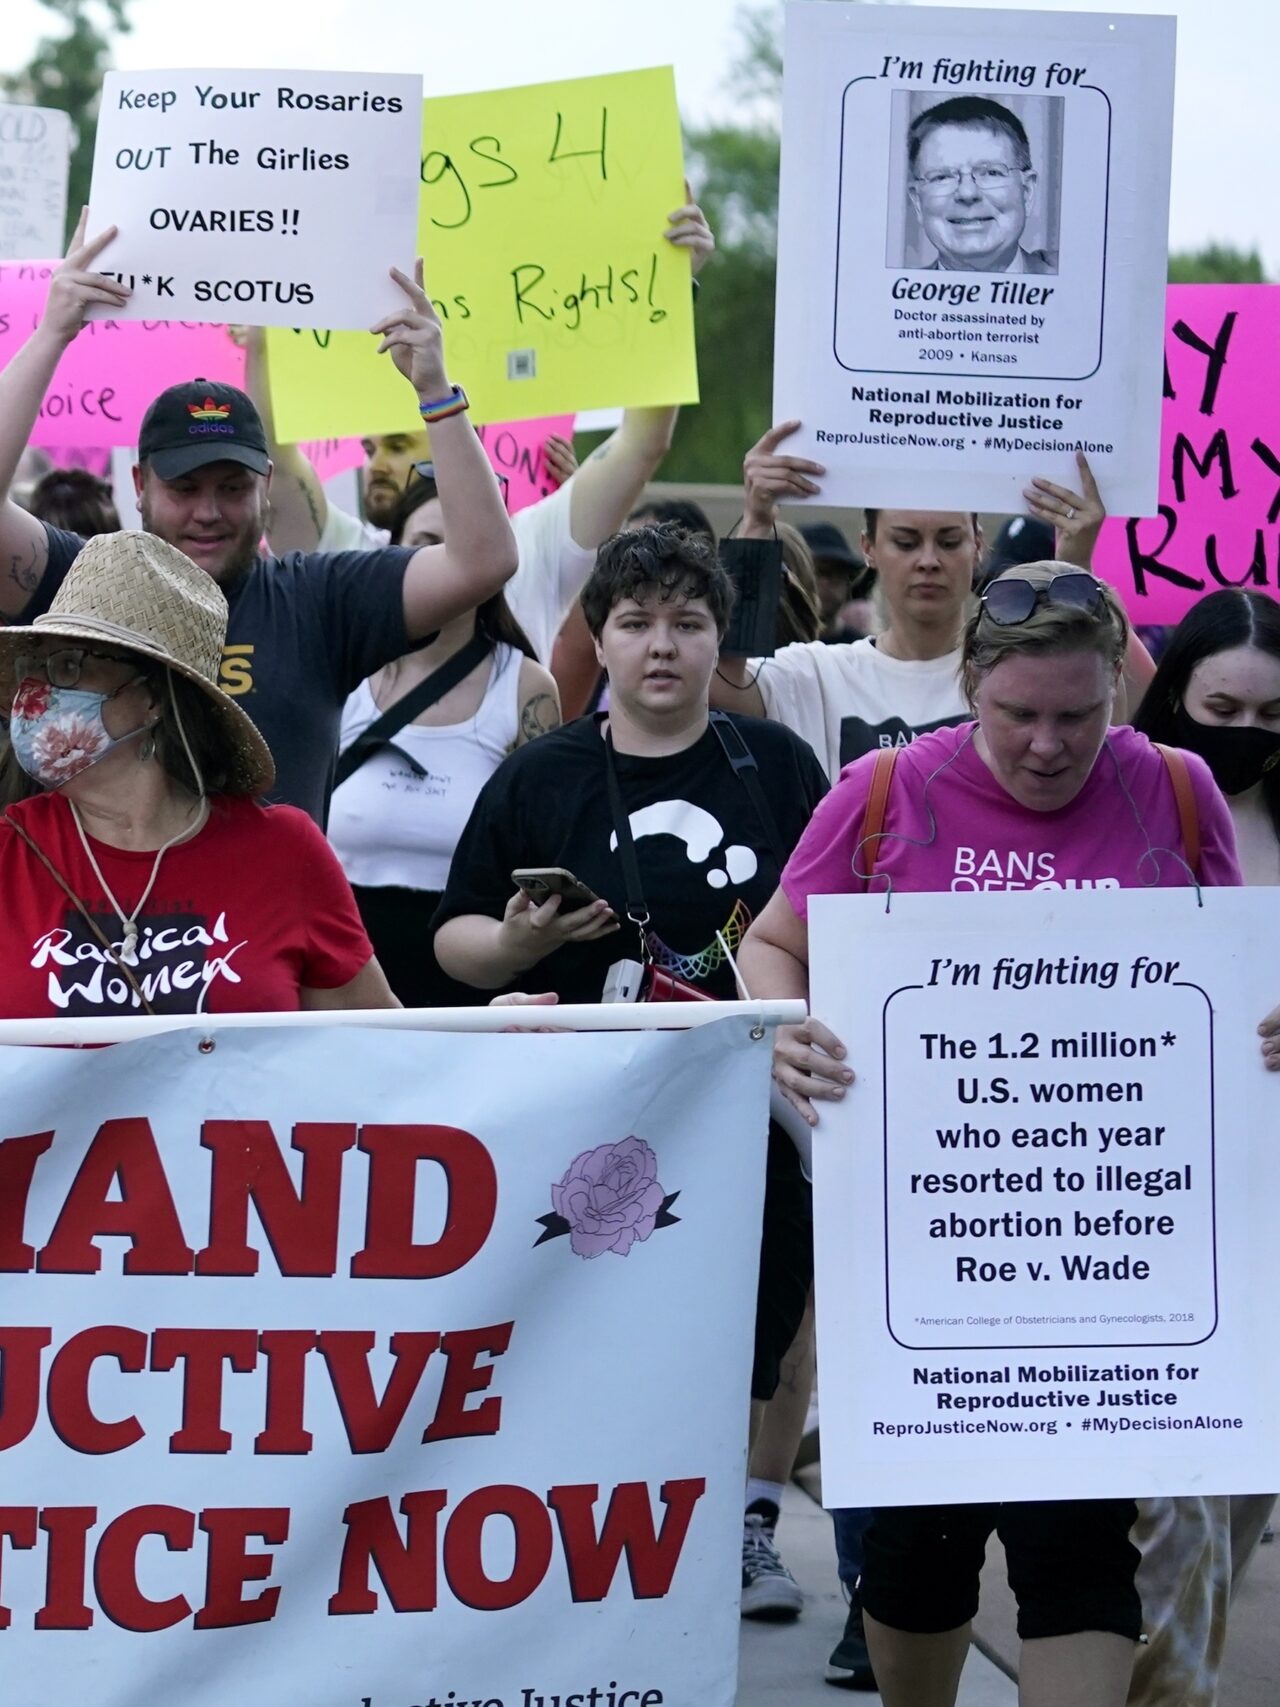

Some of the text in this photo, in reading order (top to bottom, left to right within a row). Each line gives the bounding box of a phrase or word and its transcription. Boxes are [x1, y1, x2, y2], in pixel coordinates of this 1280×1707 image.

[880, 56, 1086, 87] I'm fighting for
[119, 86, 403, 113] Keep Your Rosaries
[116, 140, 350, 171] OUT The Girlies
[420, 136, 517, 228] gs
[150, 208, 299, 235] OVARIES!!
[194, 281, 314, 304] SCOTUS
[892, 278, 1054, 306] George Tiller
[894, 309, 1046, 328] Doctor assassinated by
[898, 328, 1040, 344] anti-abortion terrorist
[919, 348, 1018, 363] 2009 Kansas
[851, 386, 1083, 409] National Mobilization for
[189, 422, 234, 434] adidas
[869, 408, 1063, 430] Reproductive Justice
[816, 430, 1113, 454] ReproJusticeNow.org #MyDecisionAlone
[1126, 504, 1280, 597] RU
[954, 846, 1055, 882] BANS
[31, 911, 229, 968] Radical
[48, 957, 241, 1009] Women
[928, 957, 1179, 990] I'm fighting for
[920, 1033, 977, 1059] The
[988, 1033, 1039, 1058] 1.2
[958, 1077, 1143, 1103] U.S. women
[936, 1122, 1165, 1153] who each year
[911, 1165, 1192, 1196] resorted to illegal
[929, 1210, 1174, 1238] abortion before
[956, 1255, 1150, 1282] Roe v. Wade
[967, 1315, 1001, 1326] College
[1003, 1314, 1013, 1325] of
[1015, 1314, 1077, 1324] Obstetricians
[1079, 1314, 1097, 1324] and
[1169, 1313, 1195, 1323] 2018
[913, 1363, 1199, 1385] National Mobilization for
[937, 1390, 1177, 1412] Reproductive Justice
[873, 1415, 1243, 1436] ReproJusticeNow.org #MyDecisionAlone
[328, 1478, 706, 1616] NOW
